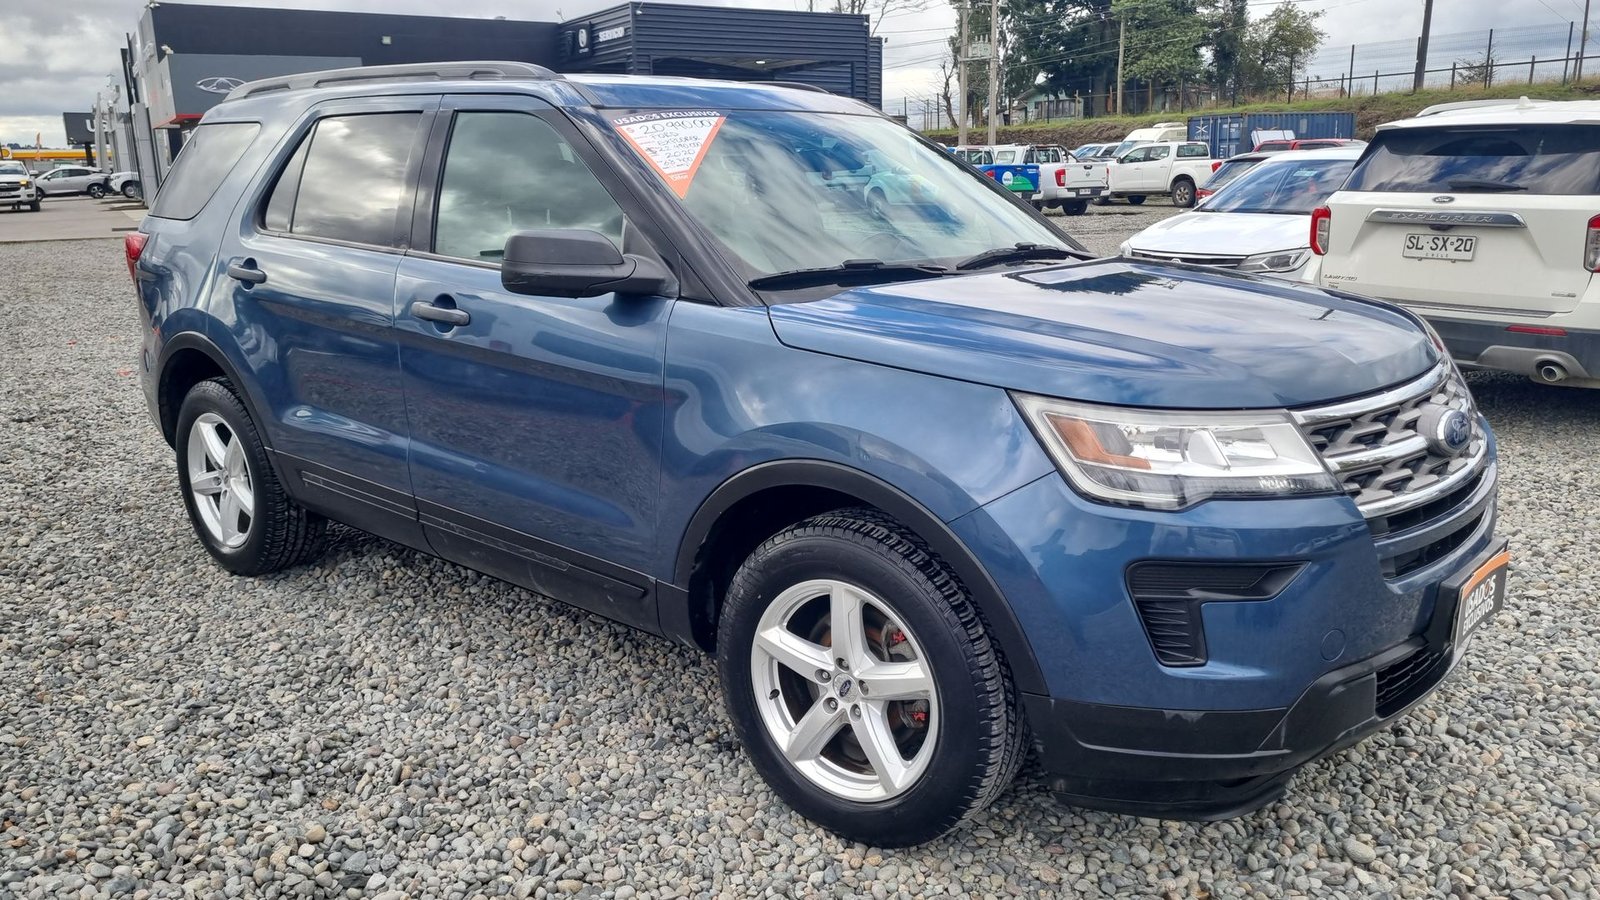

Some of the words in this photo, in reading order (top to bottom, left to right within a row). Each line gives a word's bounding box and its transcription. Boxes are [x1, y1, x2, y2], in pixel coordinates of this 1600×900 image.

[614, 112, 661, 125] USADOS
[662, 110, 721, 119] EXCLUSIVOS
[1387, 212, 1495, 223] EXPLORER
